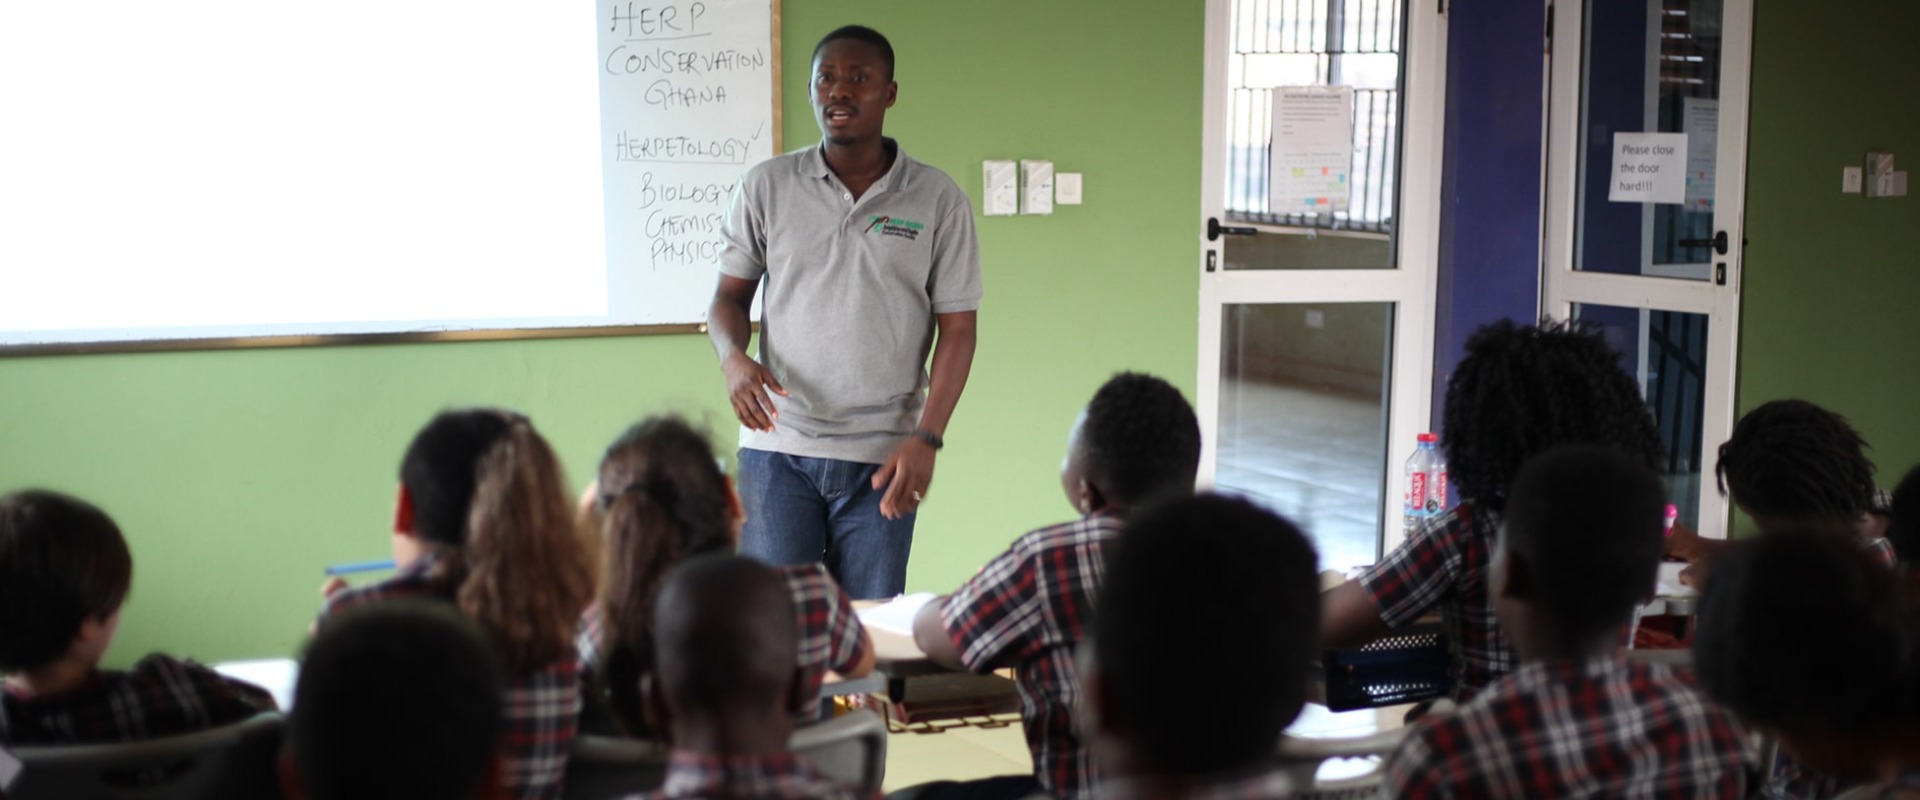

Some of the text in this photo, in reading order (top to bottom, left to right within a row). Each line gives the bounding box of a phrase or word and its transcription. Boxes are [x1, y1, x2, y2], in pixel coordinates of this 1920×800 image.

[611, 1, 705, 37] HERP
[605, 45, 764, 76] CONSERVATION
[645, 79, 727, 110] GHANA
[616, 130, 750, 163] HERPETOLOGY
[1622, 144, 1675, 155] Please close
[1620, 162, 1660, 173] the door
[640, 171, 734, 209] BIOLOGY
[1619, 181, 1653, 192] hard!!!
[651, 238, 722, 271] PHYSICS
